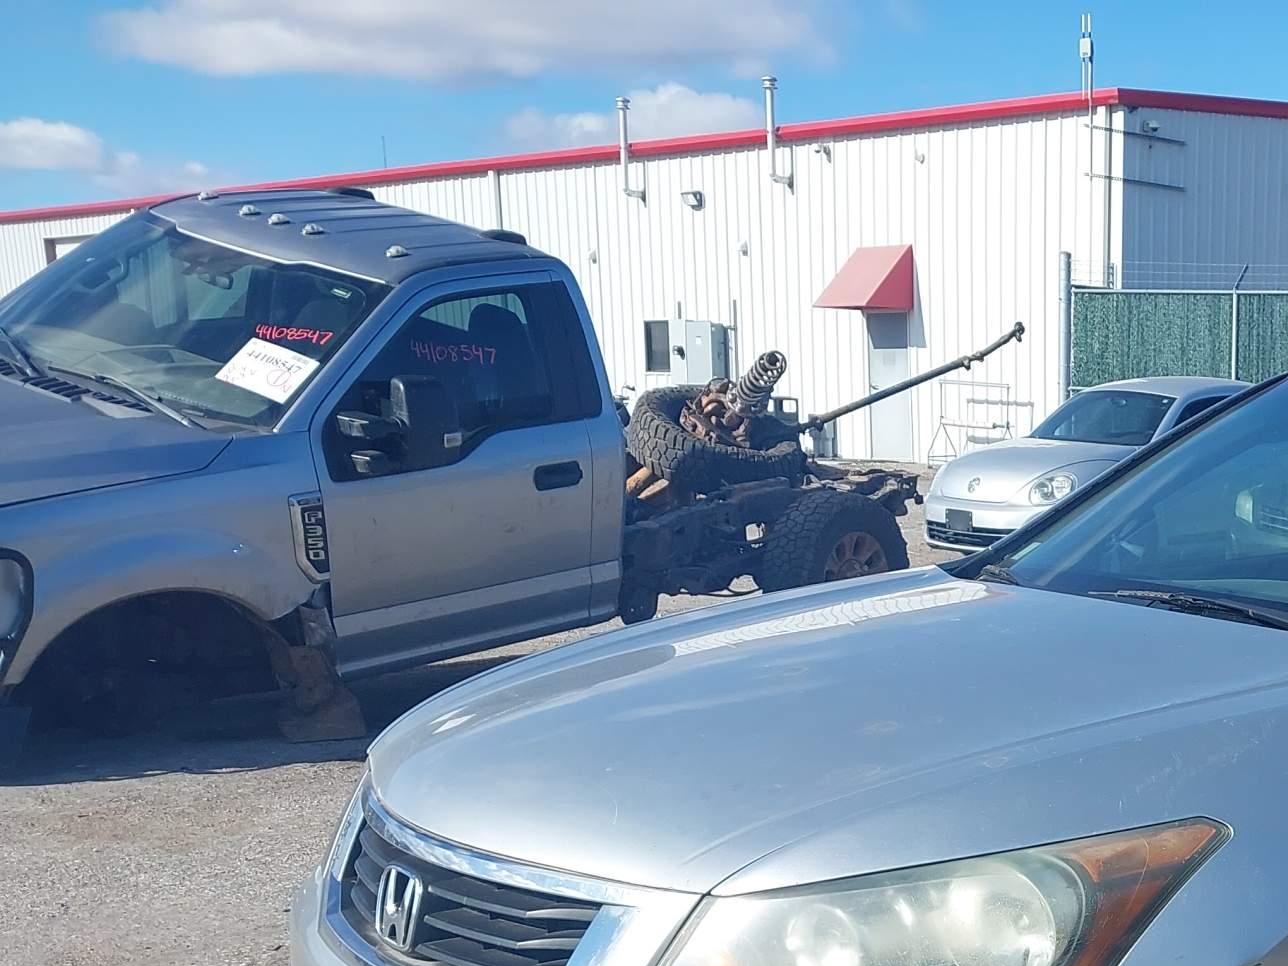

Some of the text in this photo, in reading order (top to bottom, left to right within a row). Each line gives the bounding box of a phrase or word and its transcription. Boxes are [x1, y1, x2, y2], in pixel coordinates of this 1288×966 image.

[255, 323, 334, 345] 44108547
[409, 337, 497, 366] 44108547
[303, 511, 325, 560] F350
